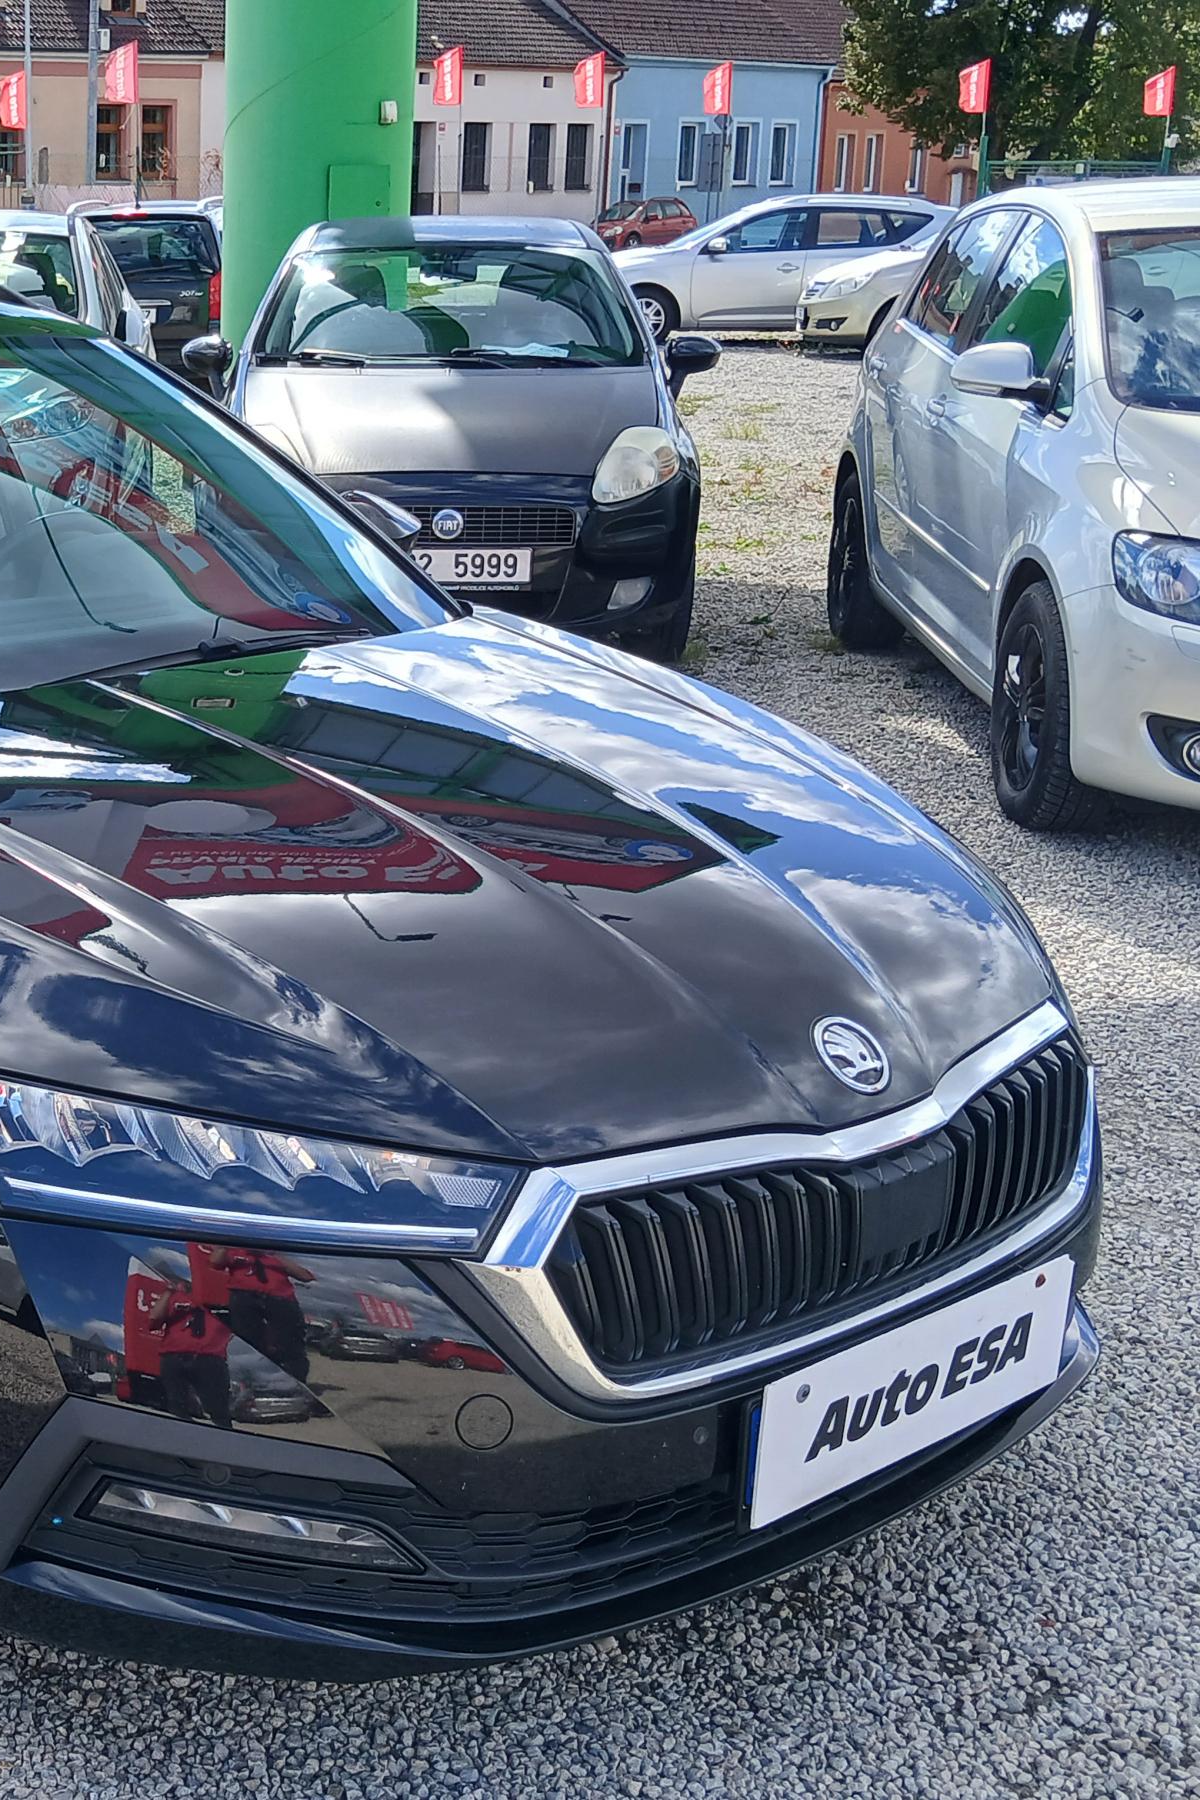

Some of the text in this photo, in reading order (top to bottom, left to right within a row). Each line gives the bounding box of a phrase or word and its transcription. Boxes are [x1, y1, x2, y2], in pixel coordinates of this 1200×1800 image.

[437, 519, 459, 531] FIAT
[454, 552, 518, 578] 5999
[804, 1311, 1034, 1463] Auto ESA
